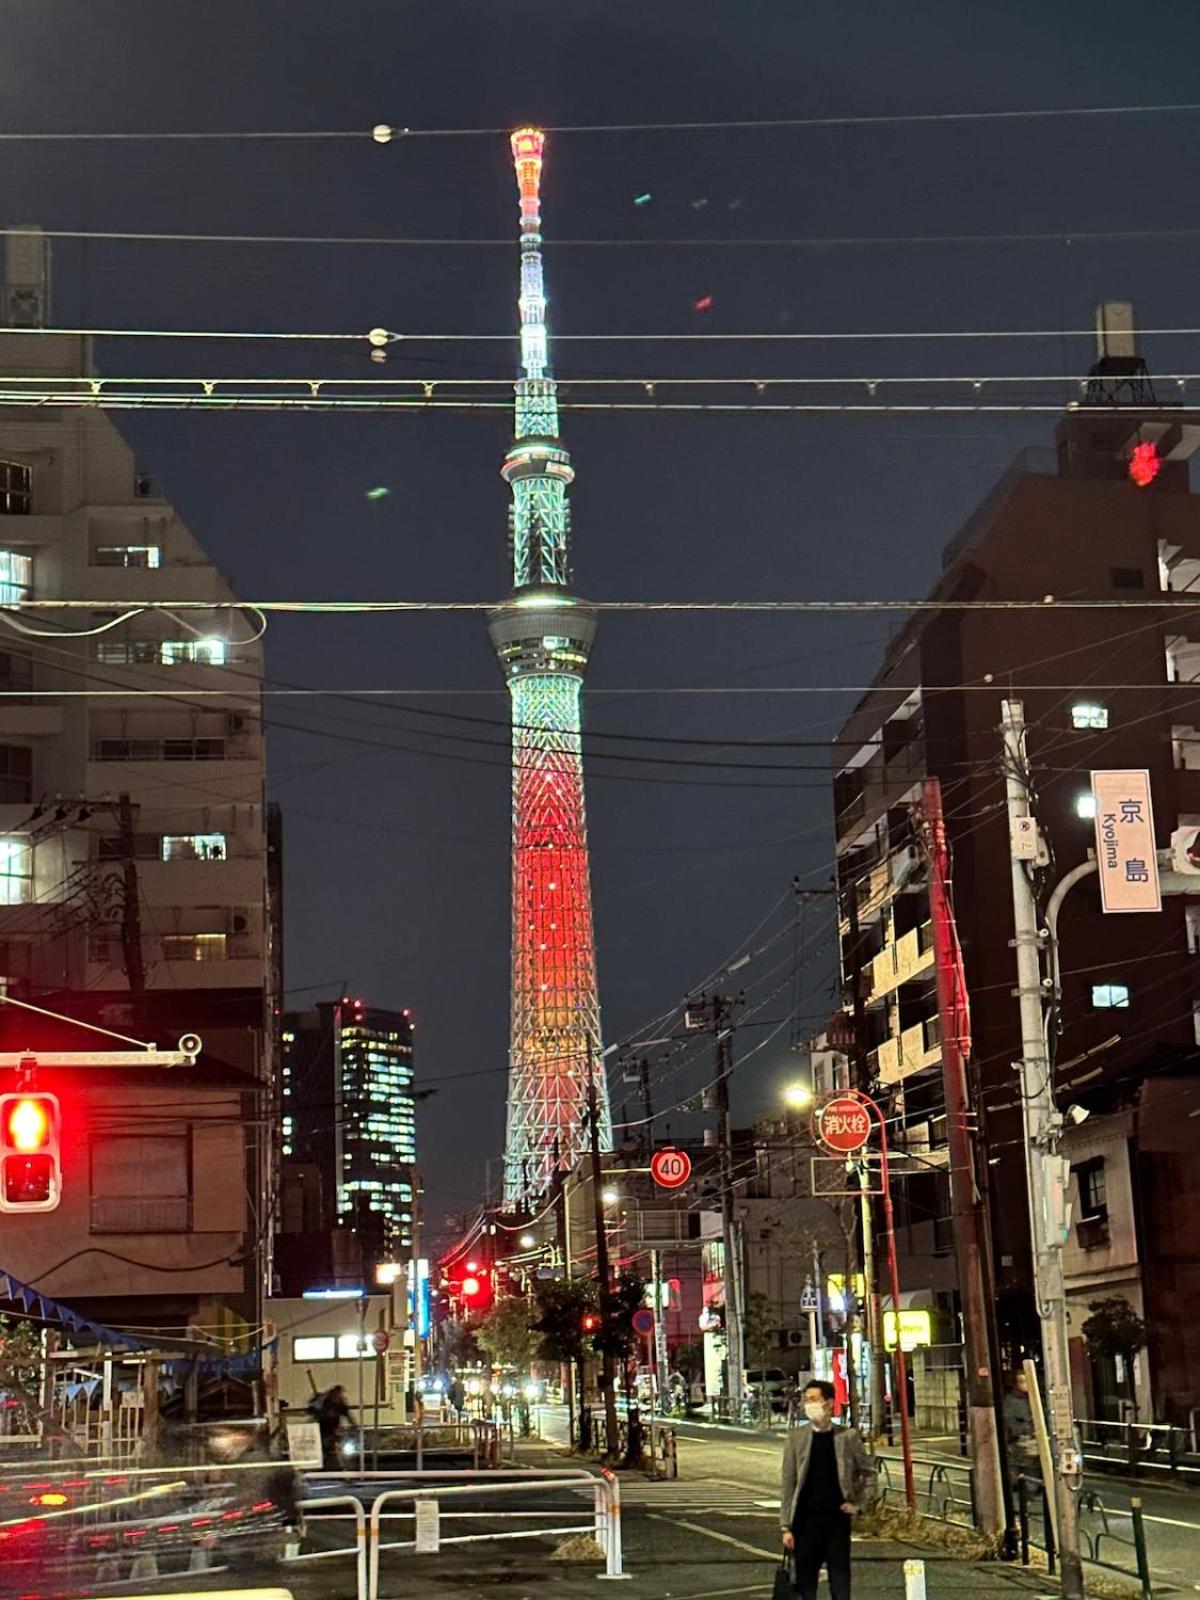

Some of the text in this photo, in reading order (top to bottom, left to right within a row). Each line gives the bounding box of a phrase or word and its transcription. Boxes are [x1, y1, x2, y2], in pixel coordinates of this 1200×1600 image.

[1102, 813, 1118, 868] Kyojima
[1118, 799, 1149, 882] 京島
[824, 1113, 867, 1134] 消火栓
[661, 1159, 681, 1175] 40
